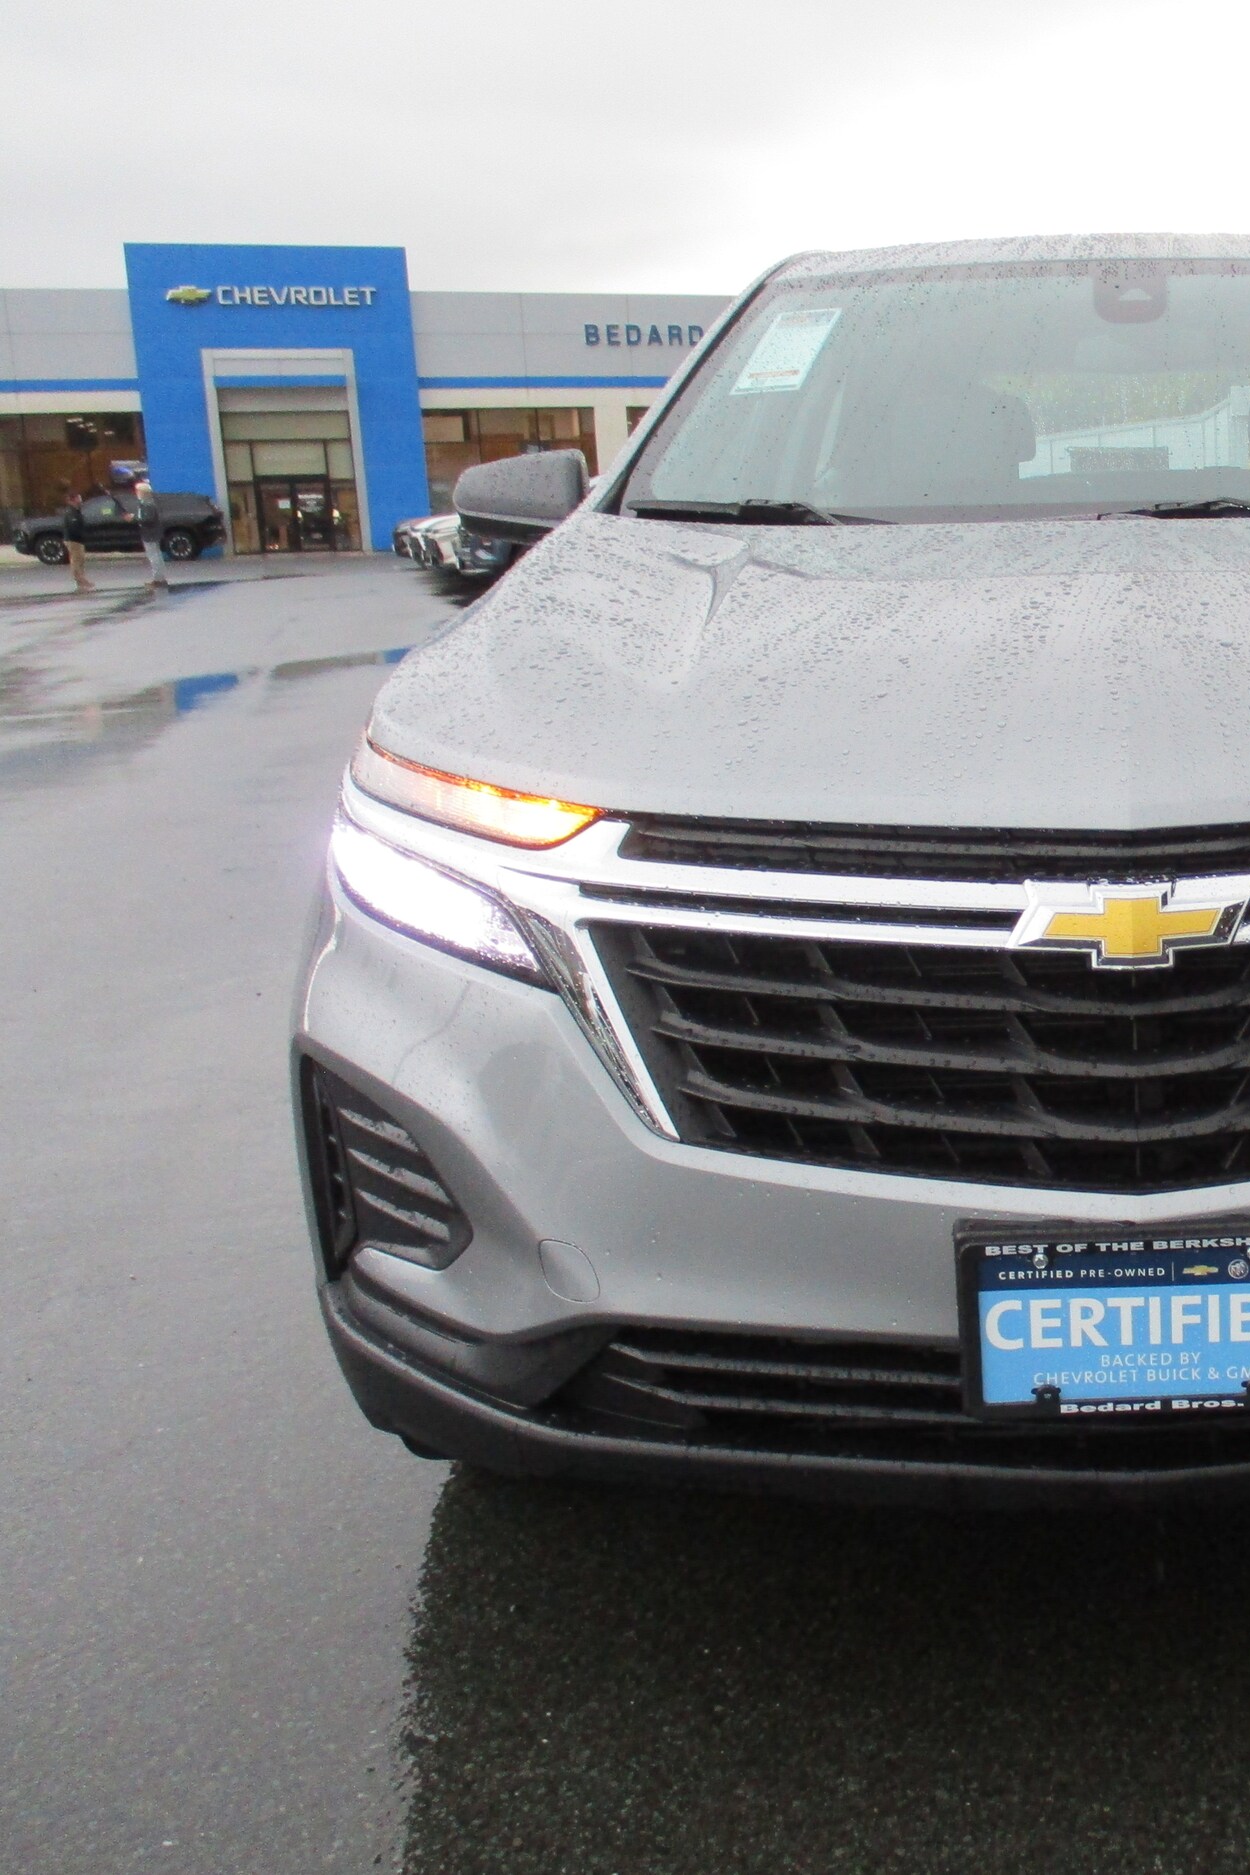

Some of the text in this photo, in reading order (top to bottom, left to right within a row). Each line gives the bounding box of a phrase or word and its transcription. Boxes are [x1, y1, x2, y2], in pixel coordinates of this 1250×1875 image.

[216, 286, 377, 306] CHEVROLET
[584, 324, 704, 346] BEDARD
[985, 1244, 1048, 1257] BEST
[1056, 1243, 1090, 1254] OF
[1094, 1241, 1145, 1252] THE
[998, 1267, 1166, 1280] CERTIFIED PRE-OWNED
[1101, 1351, 1202, 1367] BACKED BY
[1033, 1368, 1140, 1386] CHEVROLET
[1147, 1367, 1204, 1381] BUICK
[1209, 1366, 1222, 1380] &
[1060, 1398, 1245, 1414] Bedard Bros.
